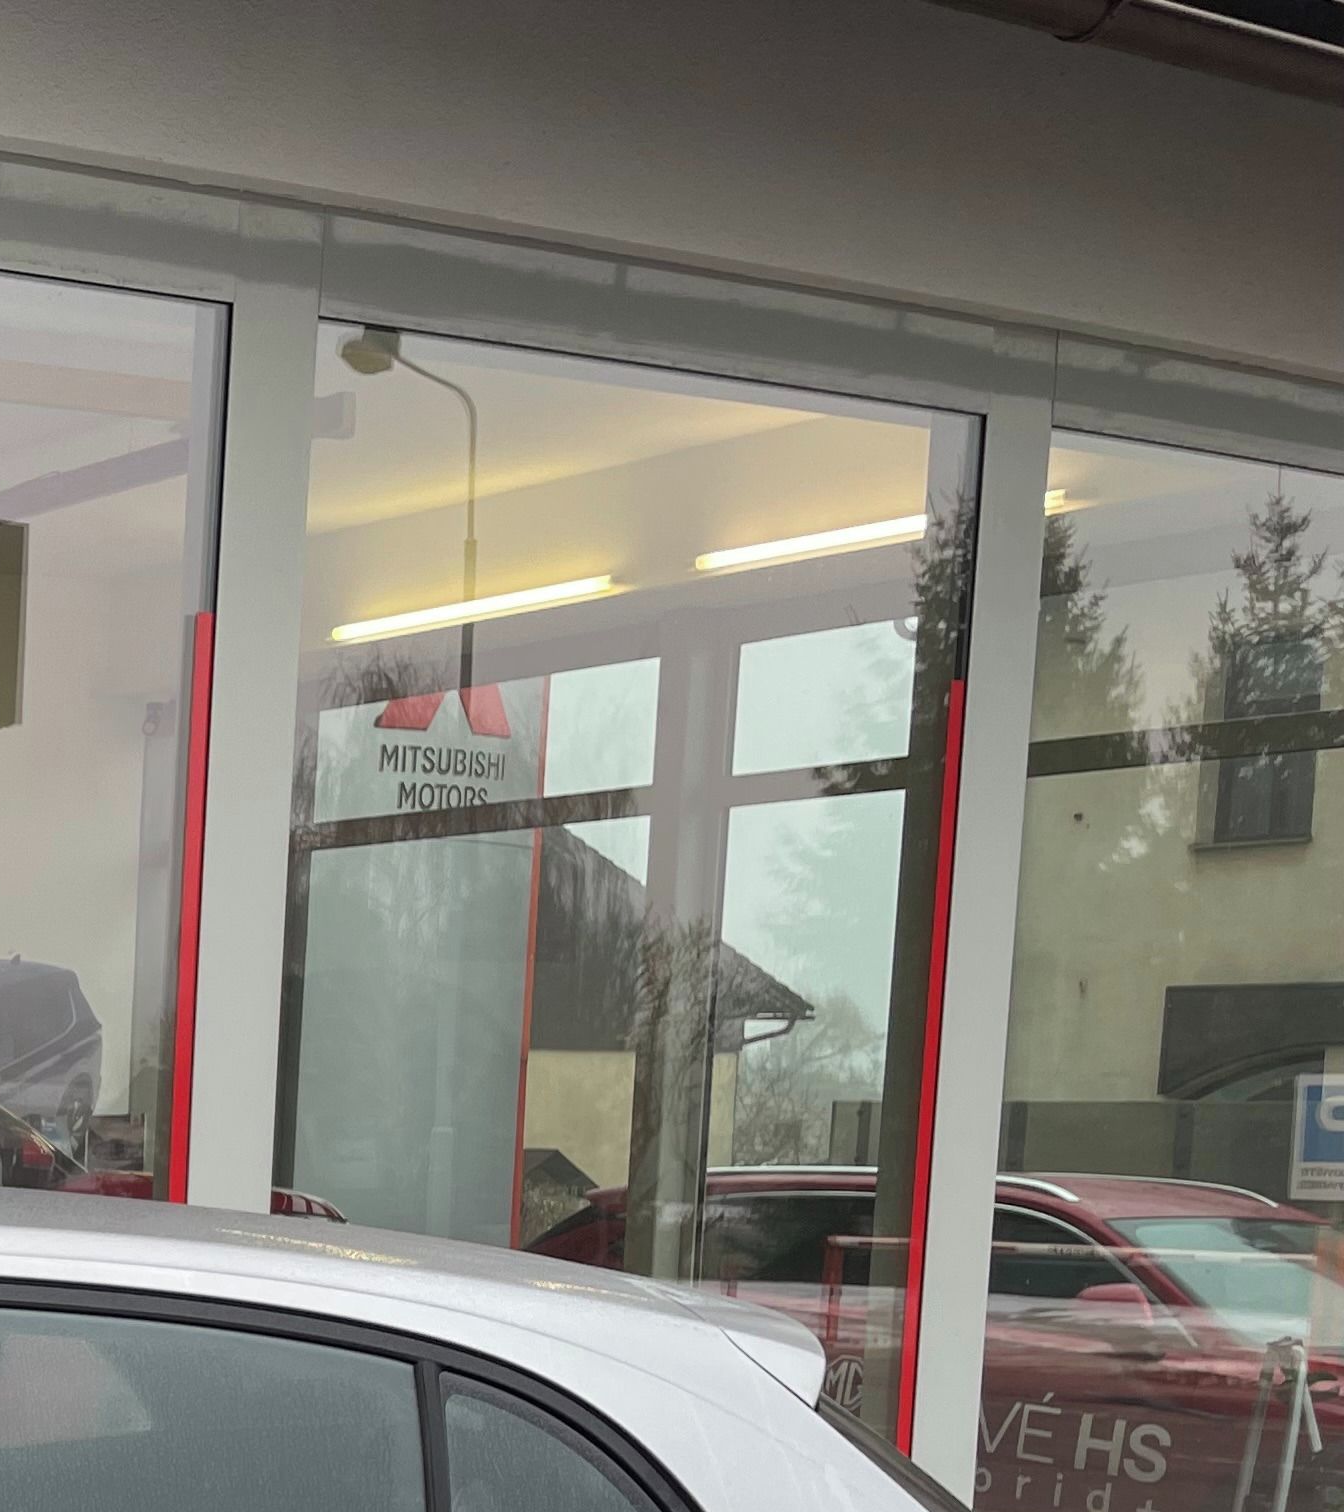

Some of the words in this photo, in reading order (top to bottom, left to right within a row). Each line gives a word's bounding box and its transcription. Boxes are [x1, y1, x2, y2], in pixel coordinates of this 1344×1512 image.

[378, 743, 506, 781] MITSUBISHI
[396, 781, 489, 811] MOTORS
[1074, 1413, 1172, 1483] HS
